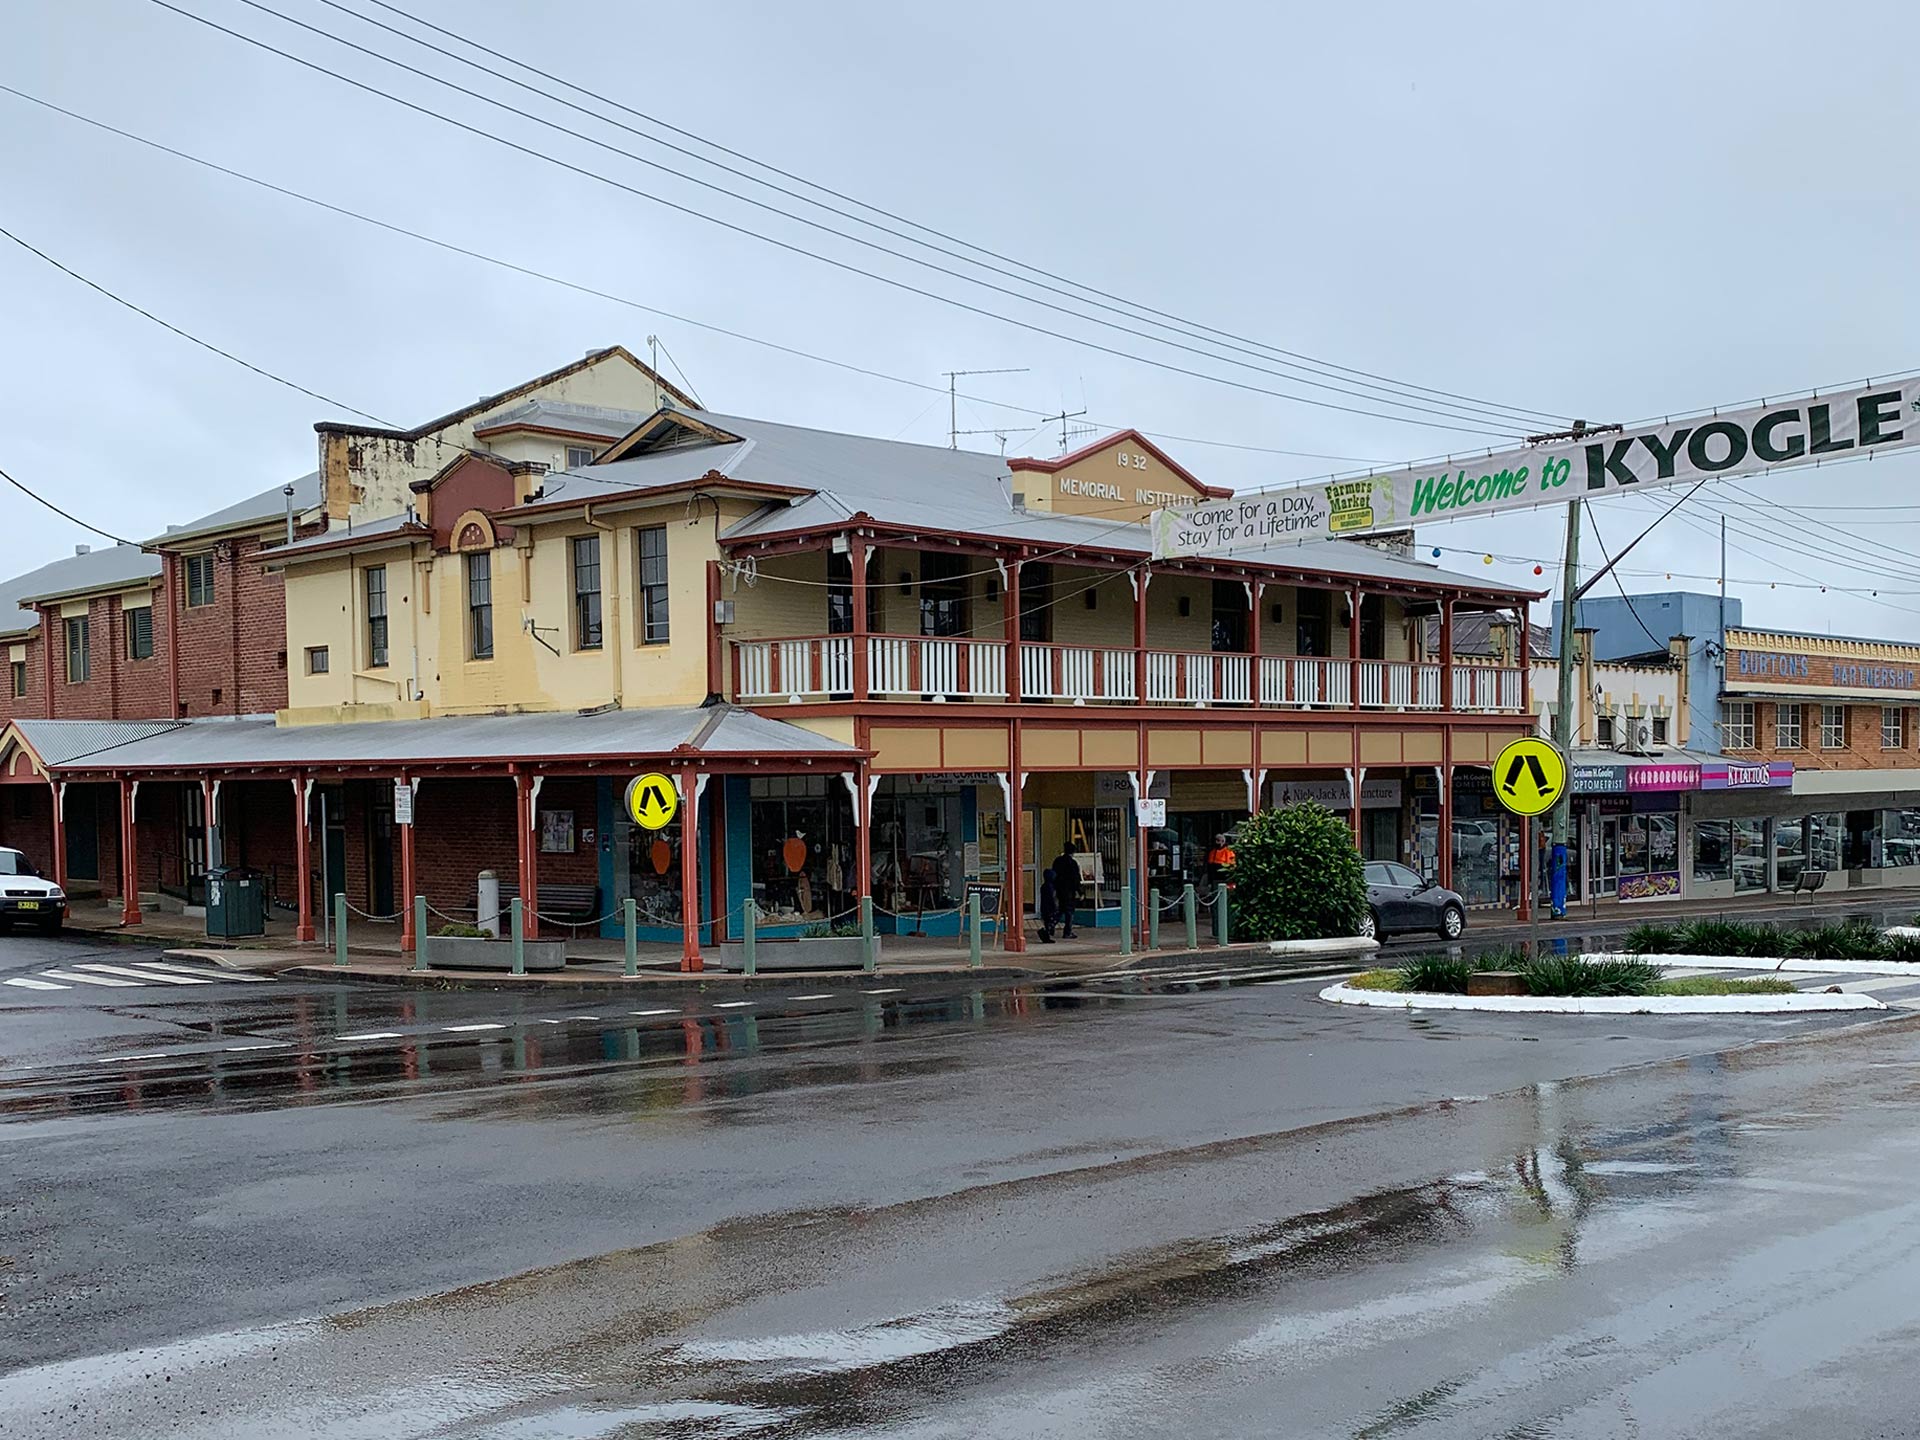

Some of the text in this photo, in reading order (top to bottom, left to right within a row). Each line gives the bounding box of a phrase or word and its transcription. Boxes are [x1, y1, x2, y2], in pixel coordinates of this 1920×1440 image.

[1410, 390, 1904, 516] Welcome to KYOGLE
[1060, 478, 1125, 501] MEMORIAL
[1324, 482, 1372, 512] Farmers Market
[1186, 496, 1314, 527] "Come for a Day,
[1217, 523, 1239, 546] for
[1244, 524, 1254, 538] a
[1260, 511, 1326, 538] Lifetime"
[1833, 664, 1914, 688] PARTNERSHIP
[1316, 787, 1337, 801] Jack
[1338, 788, 1393, 800] Acuncture
[1573, 780, 1622, 790] OPTOMETRIST
